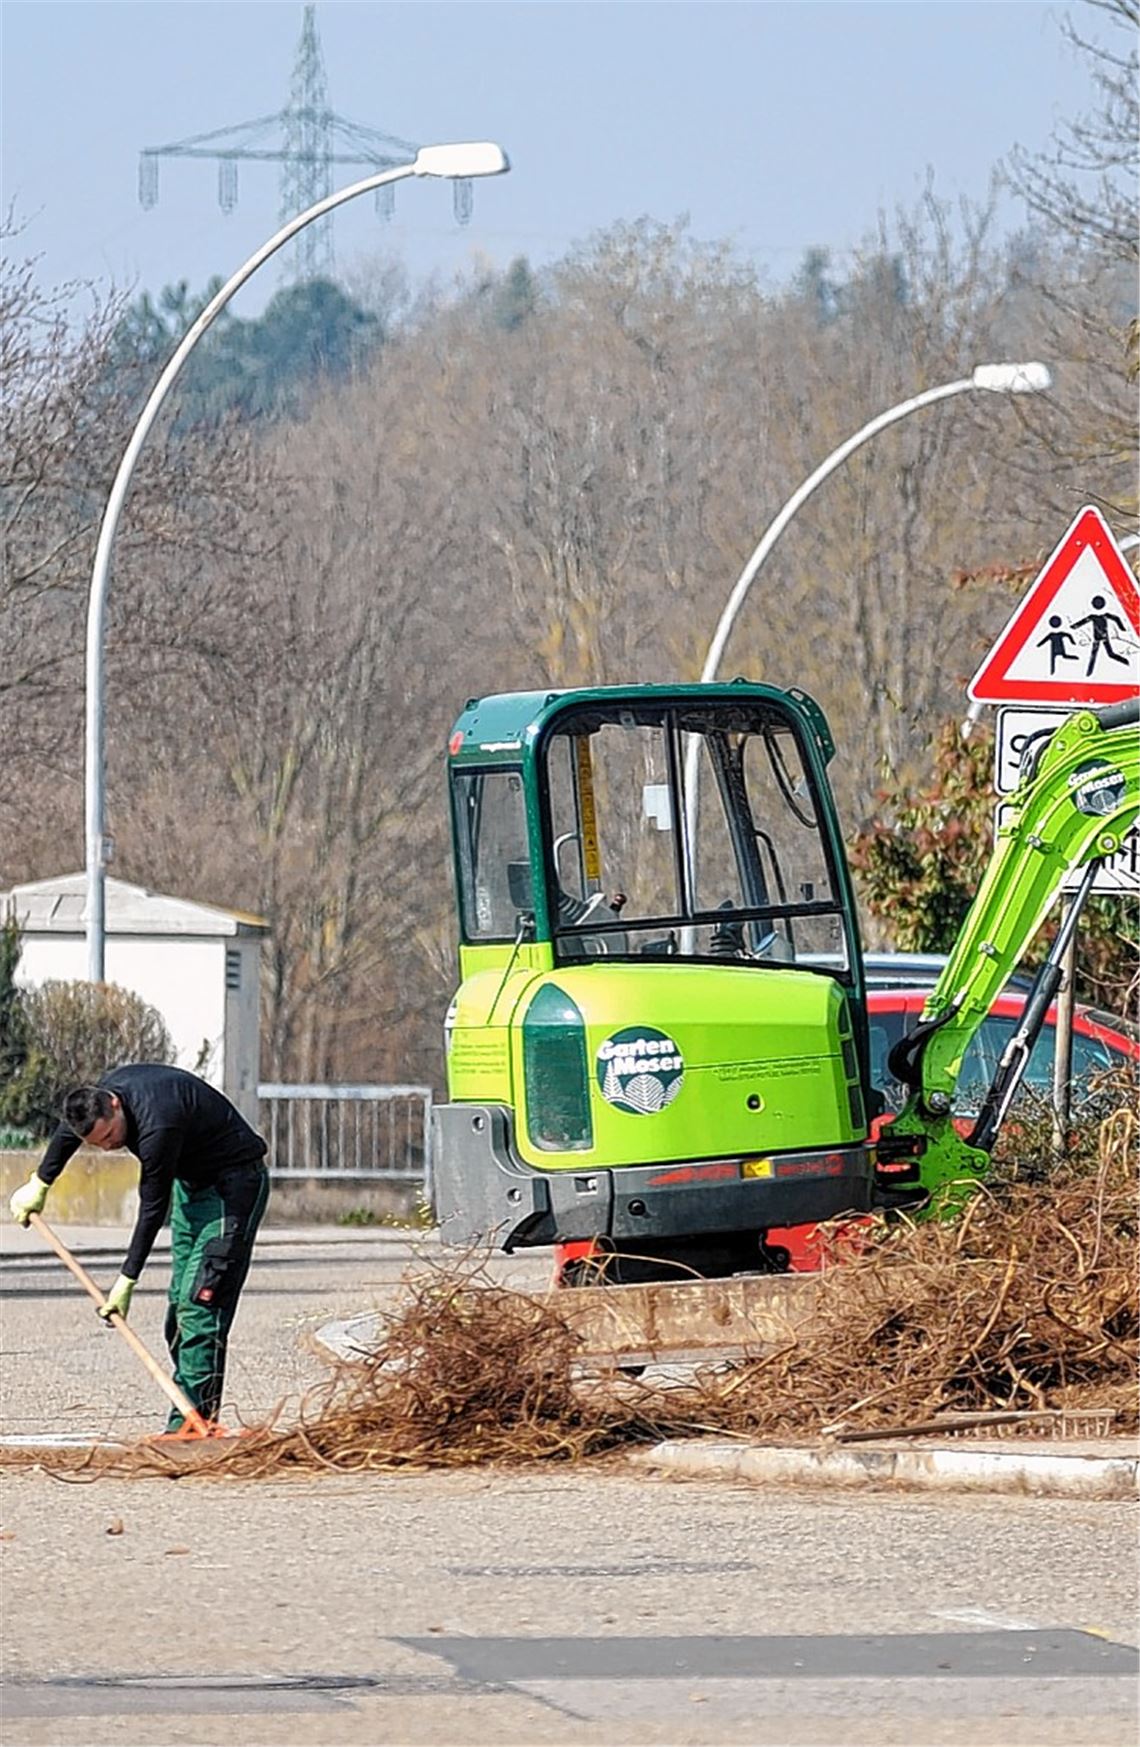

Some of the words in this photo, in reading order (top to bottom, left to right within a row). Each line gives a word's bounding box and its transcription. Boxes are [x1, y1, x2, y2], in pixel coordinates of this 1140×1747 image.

[1081, 773, 1124, 795] Moser
[597, 1039, 675, 1060] Garten
[613, 1055, 683, 1075] Moser
